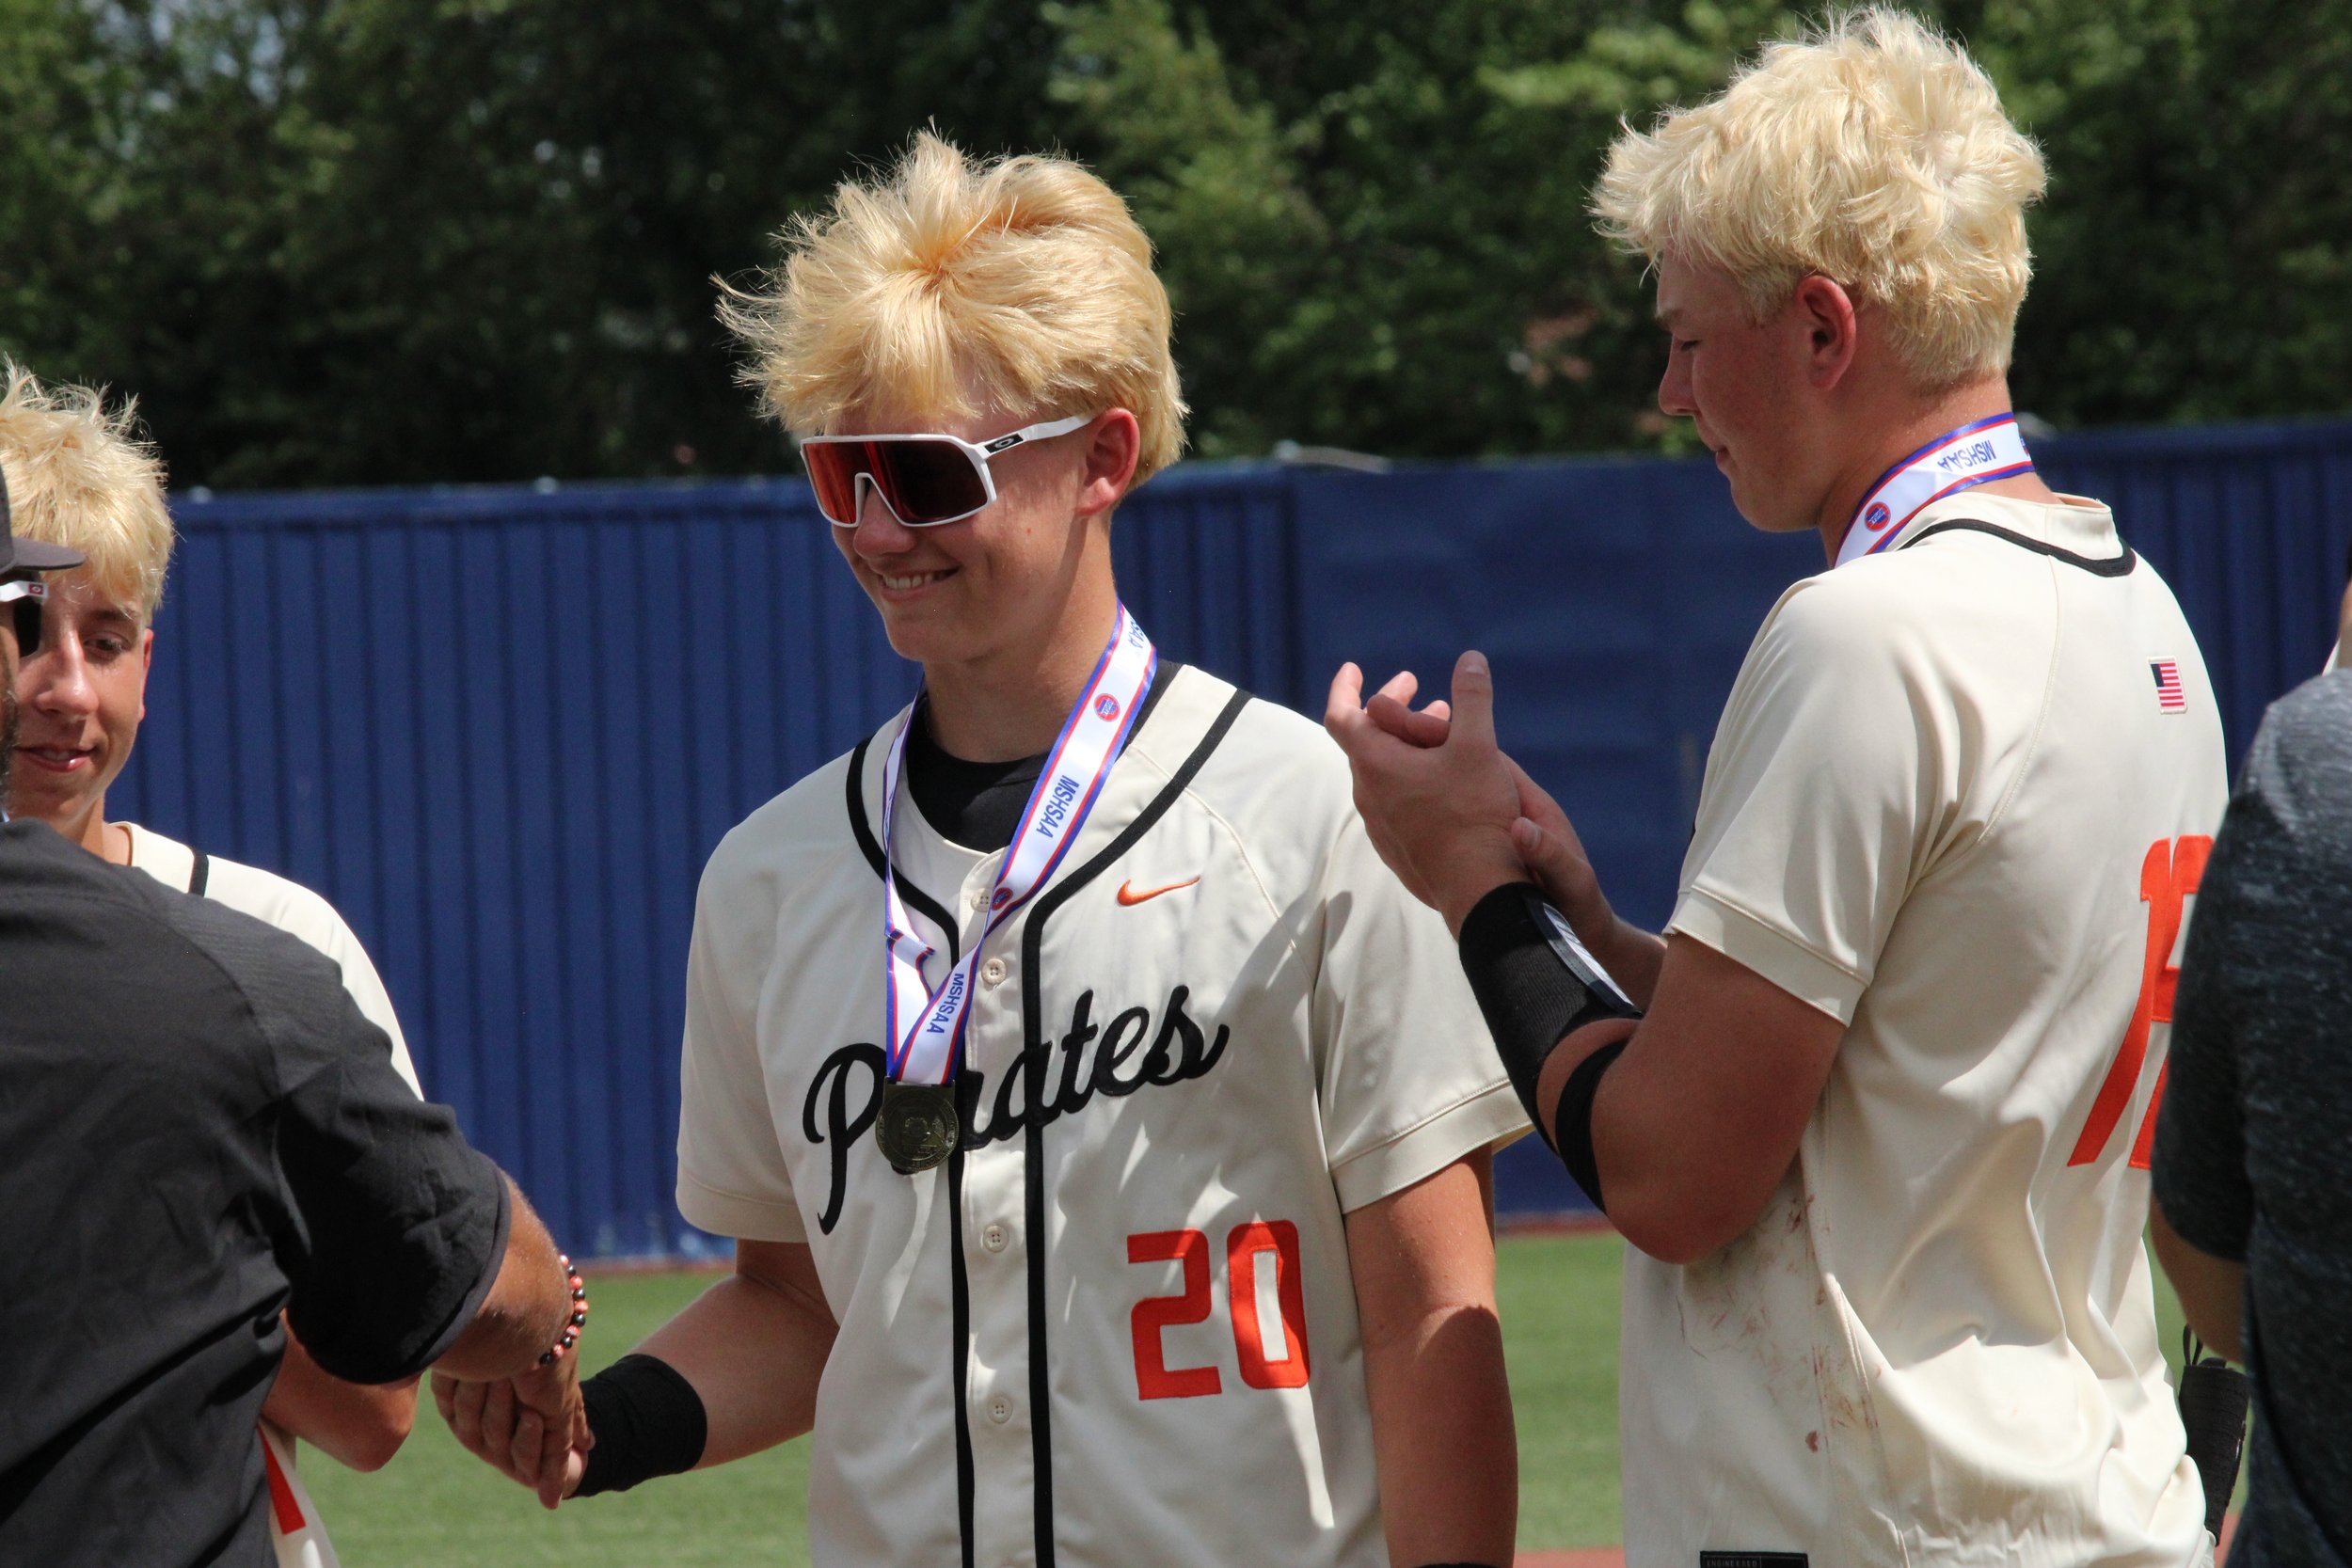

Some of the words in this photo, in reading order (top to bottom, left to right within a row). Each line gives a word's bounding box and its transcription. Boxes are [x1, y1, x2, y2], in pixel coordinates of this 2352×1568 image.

[1938, 439, 1996, 472] MSHSAA
[1036, 774, 1079, 839] MSHSAA
[927, 973, 965, 1035] MSHSAA
[1127, 1220, 1311, 1401] 20
